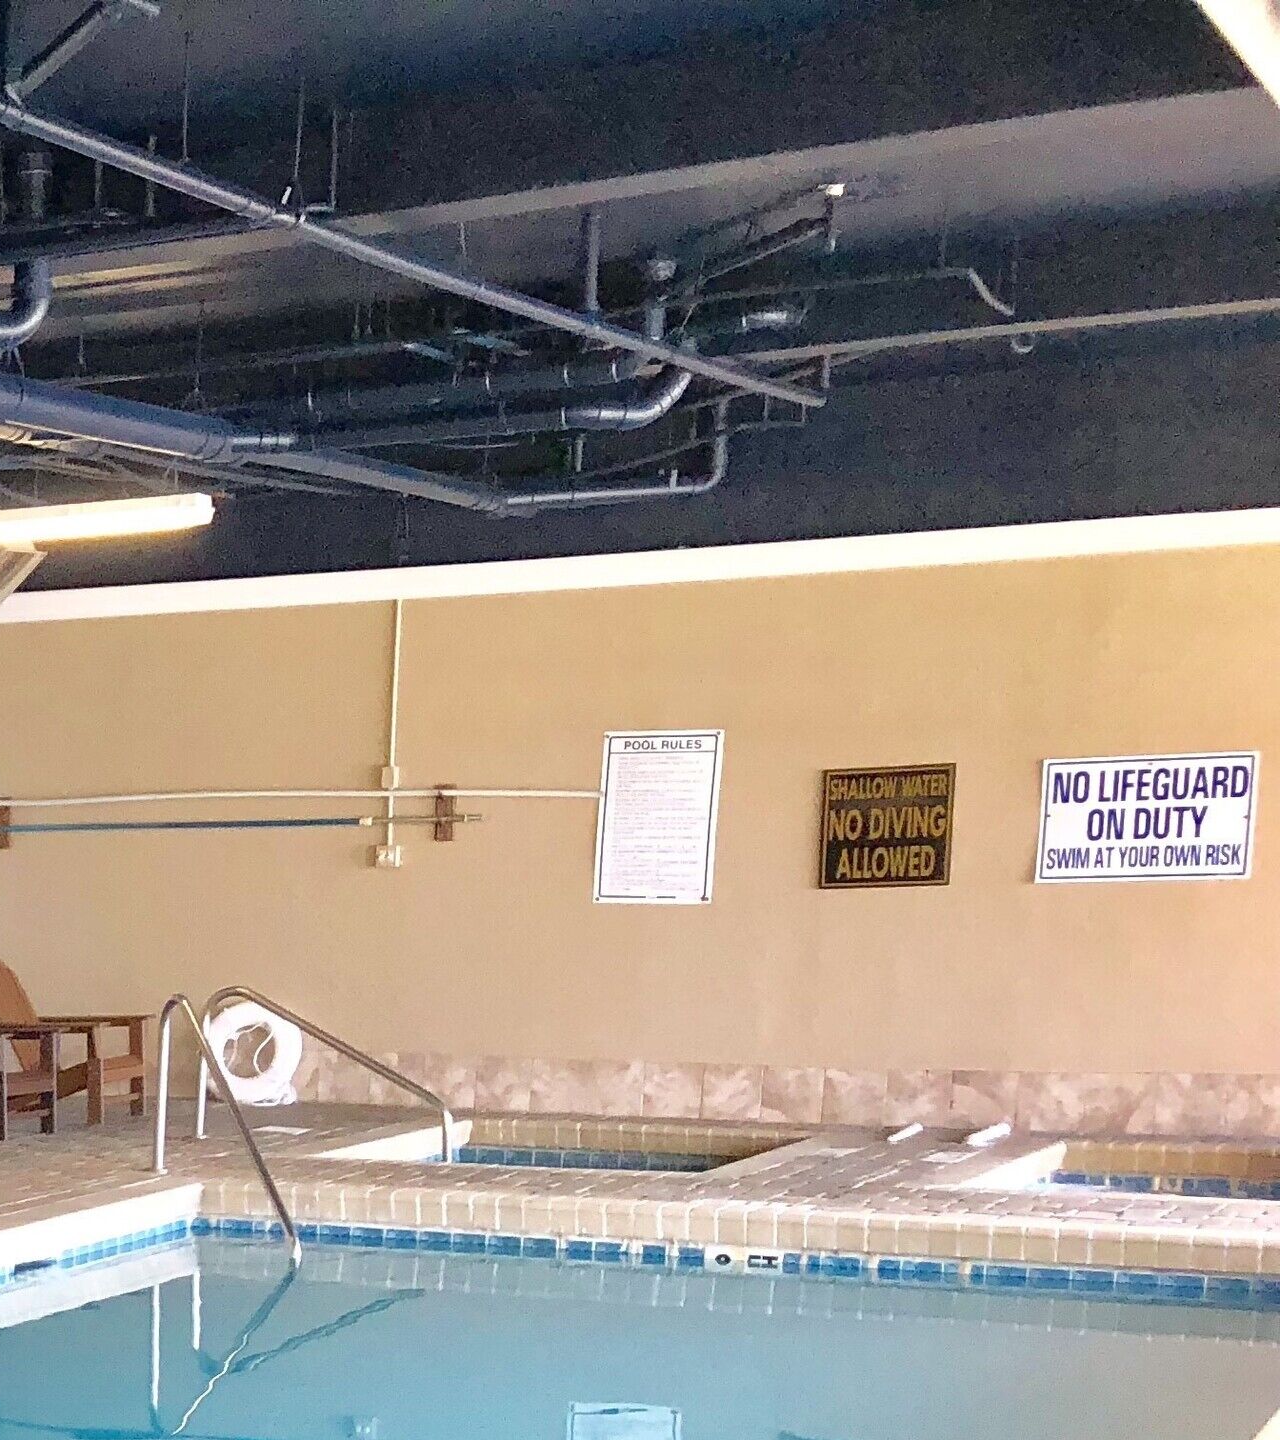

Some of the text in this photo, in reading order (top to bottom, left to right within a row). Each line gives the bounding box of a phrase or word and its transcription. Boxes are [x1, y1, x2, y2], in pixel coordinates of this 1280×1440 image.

[623, 739, 702, 750] POOL RULES
[829, 773, 948, 800] SHALLOW WATER
[1052, 765, 1250, 804] NO LIFEGUARD
[829, 804, 947, 841] NO DIVING
[1086, 805, 1208, 841] ON DUTY
[836, 844, 937, 879] ALLOWED
[1046, 843, 1242, 870] SWIM AT YOUR OWN RISK
